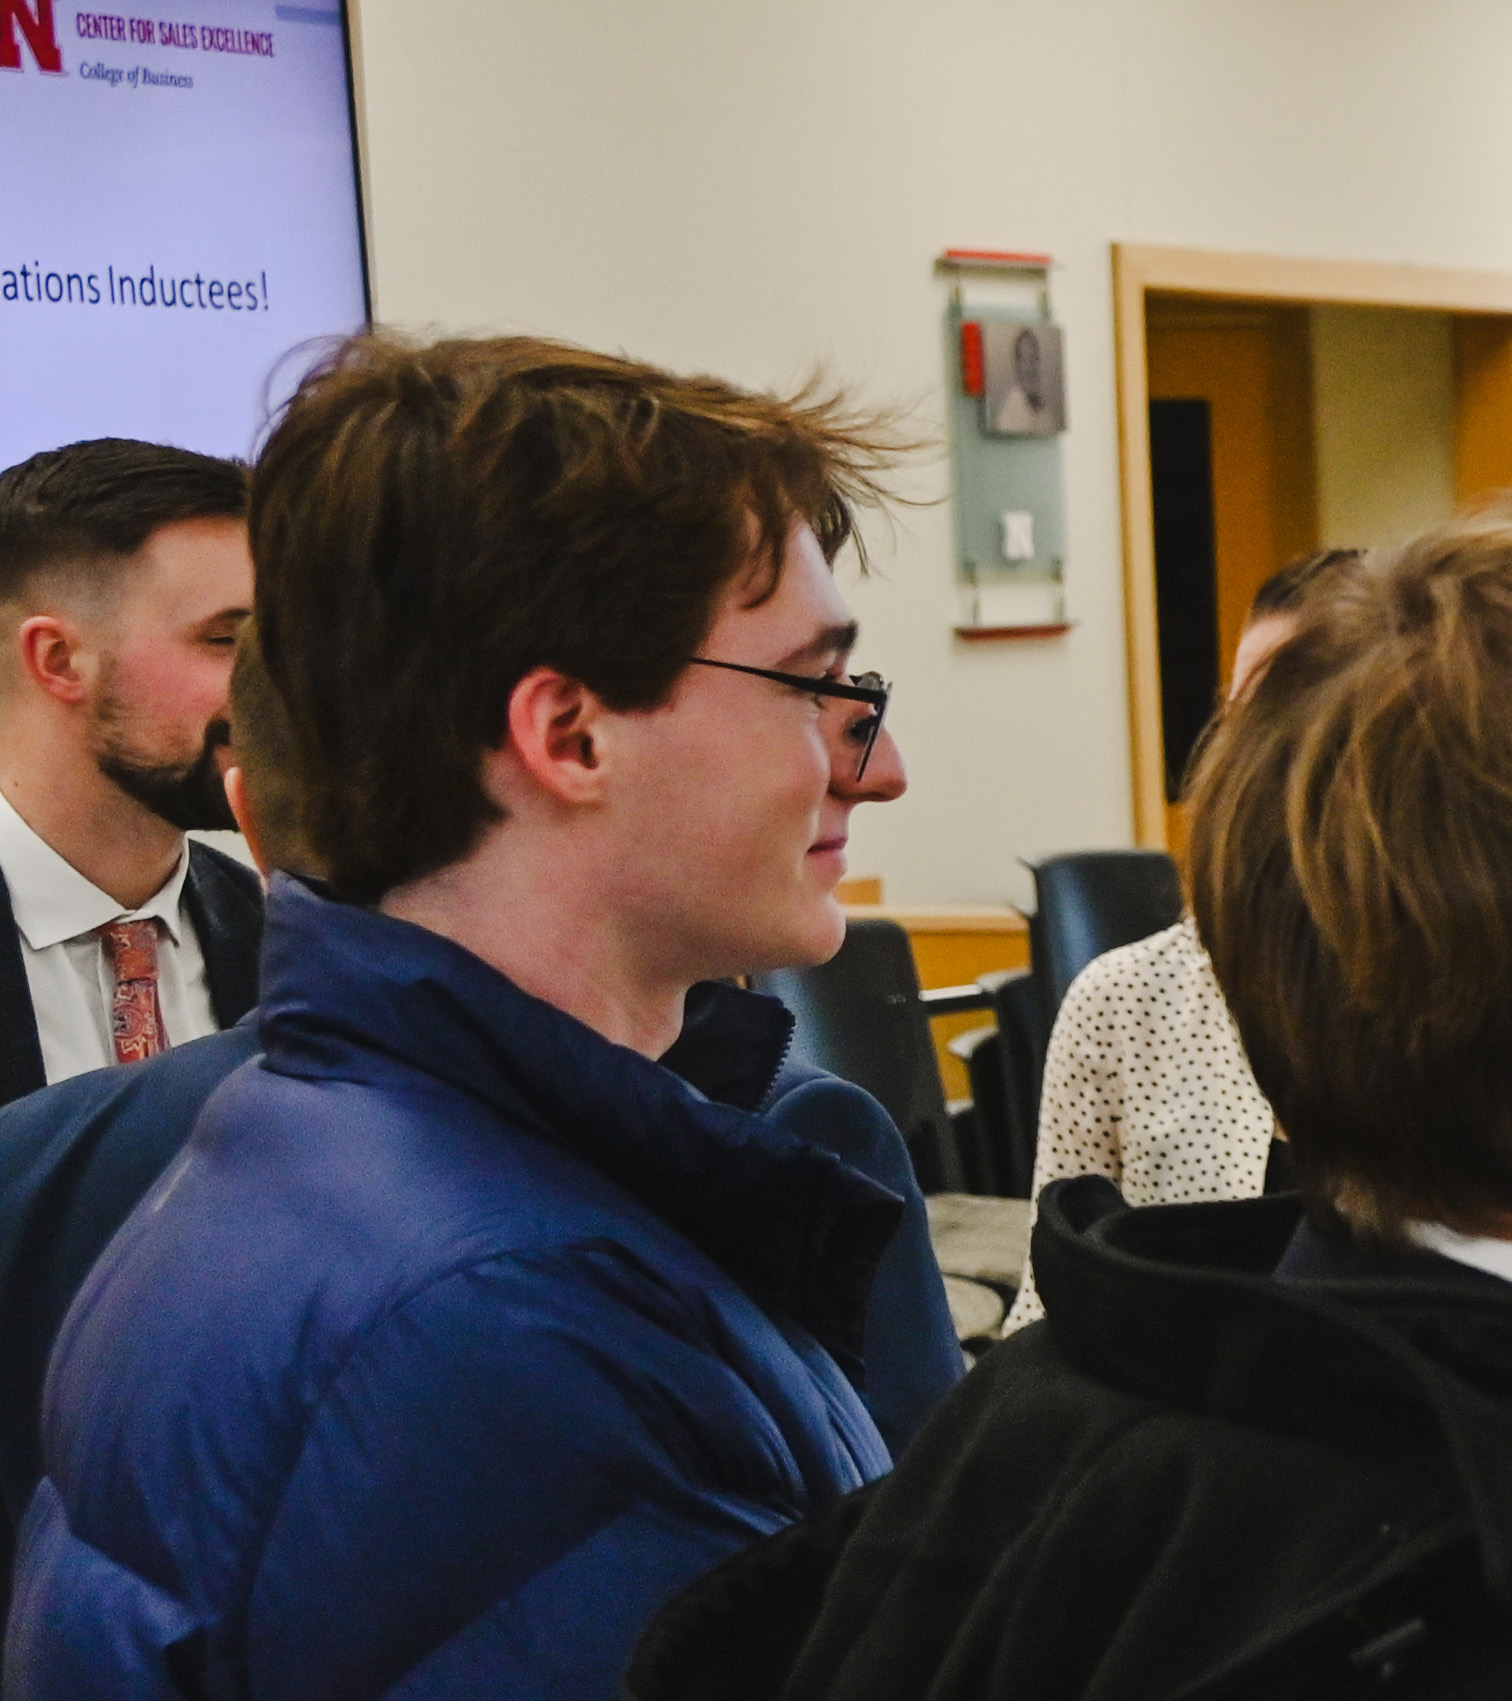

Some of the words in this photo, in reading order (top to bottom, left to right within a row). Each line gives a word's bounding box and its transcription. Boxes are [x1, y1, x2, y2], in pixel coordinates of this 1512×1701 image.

[76, 12, 127, 41] CENTER
[129, 18, 156, 44] FOR
[158, 21, 199, 49] SALES
[201, 26, 275, 57] EXCELLENCE
[79, 62, 124, 87] College
[127, 66, 140, 89] of
[142, 68, 194, 88] Business
[108, 265, 269, 311] Inductees!
